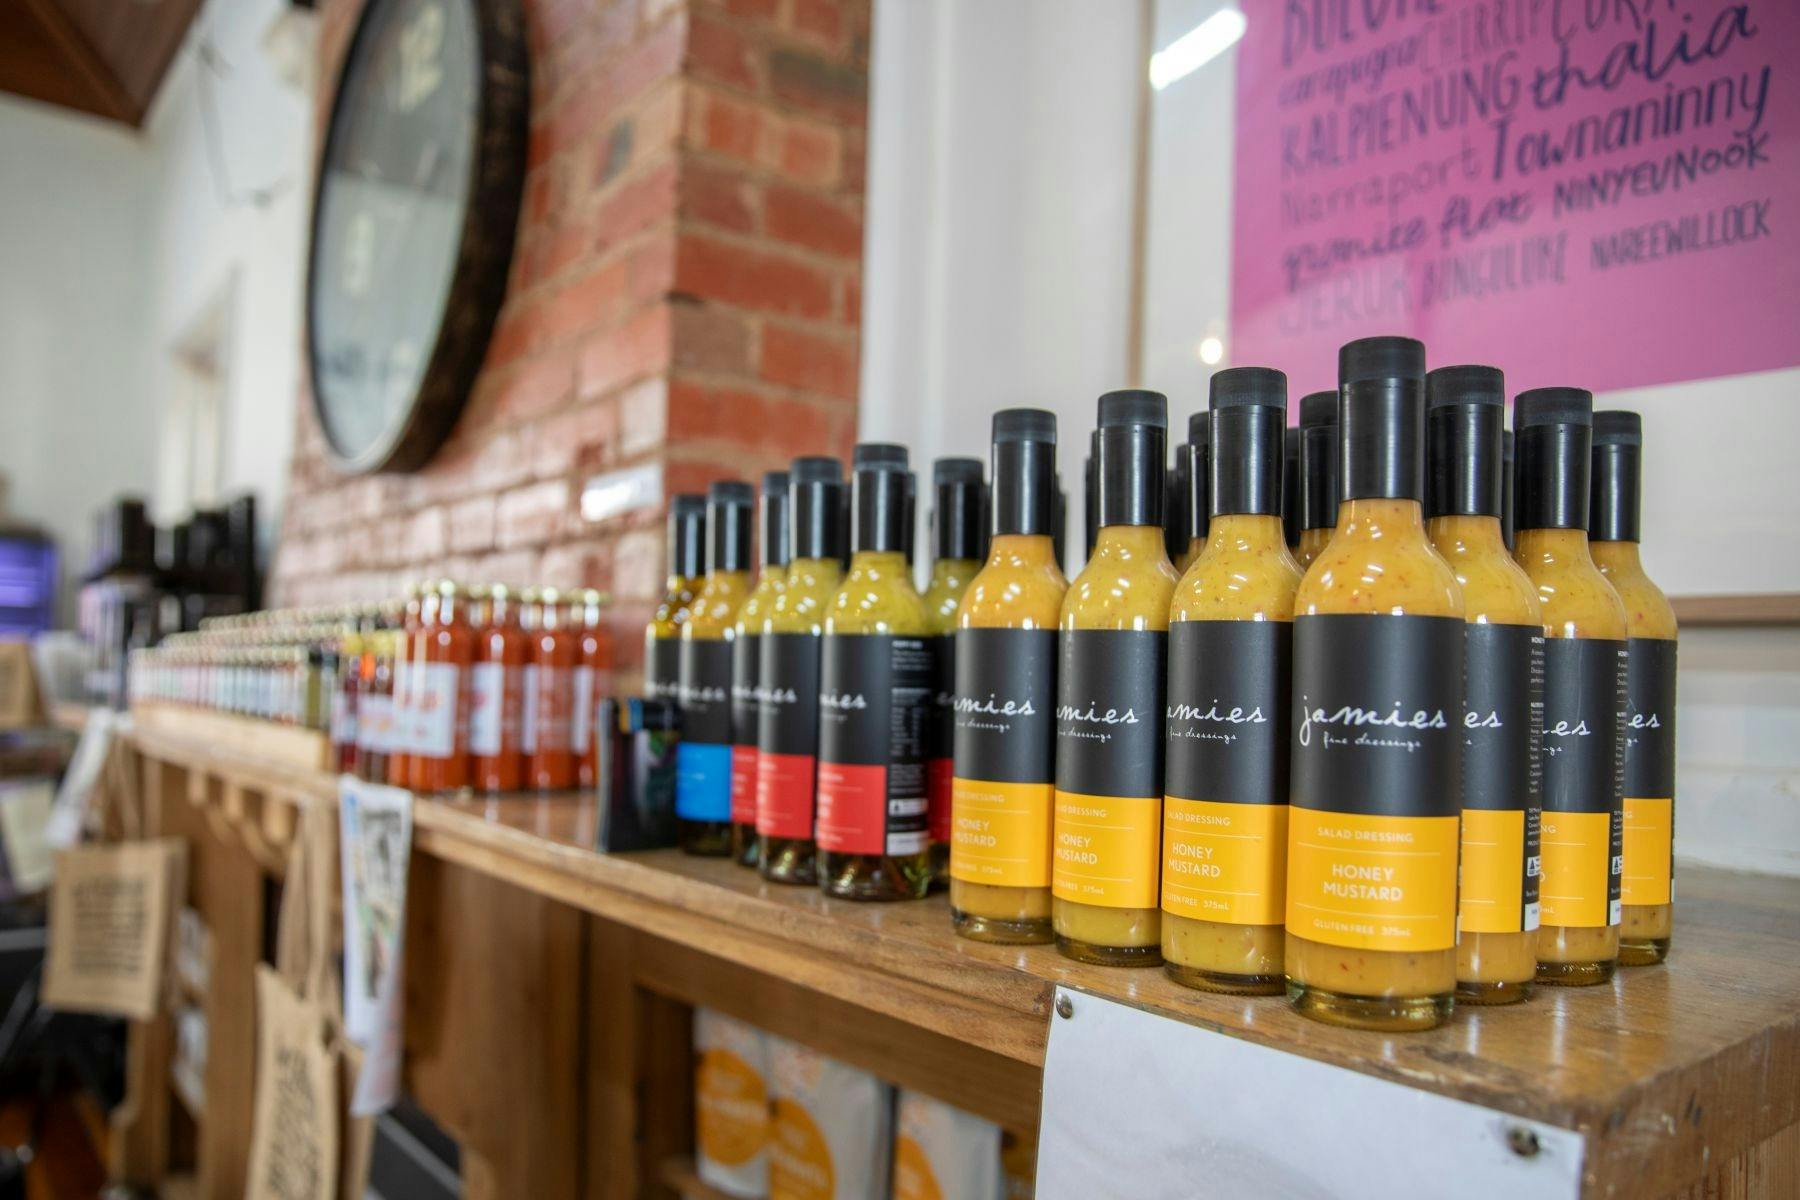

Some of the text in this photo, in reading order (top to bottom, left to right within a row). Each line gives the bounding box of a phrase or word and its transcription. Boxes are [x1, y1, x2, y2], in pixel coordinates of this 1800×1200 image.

[1533, 4, 1758, 109] thalia
[1056, 701, 1140, 724] mies
[1299, 695, 1448, 747] jamies
[1185, 813, 1232, 827] DRESSING
[1317, 826, 1415, 844] SALAD DRESSING
[1172, 842, 1213, 860] HONEY
[1168, 859, 1221, 879] MUSTARD
[1332, 863, 1395, 882] HONEY
[1323, 881, 1404, 903] MUSTARD
